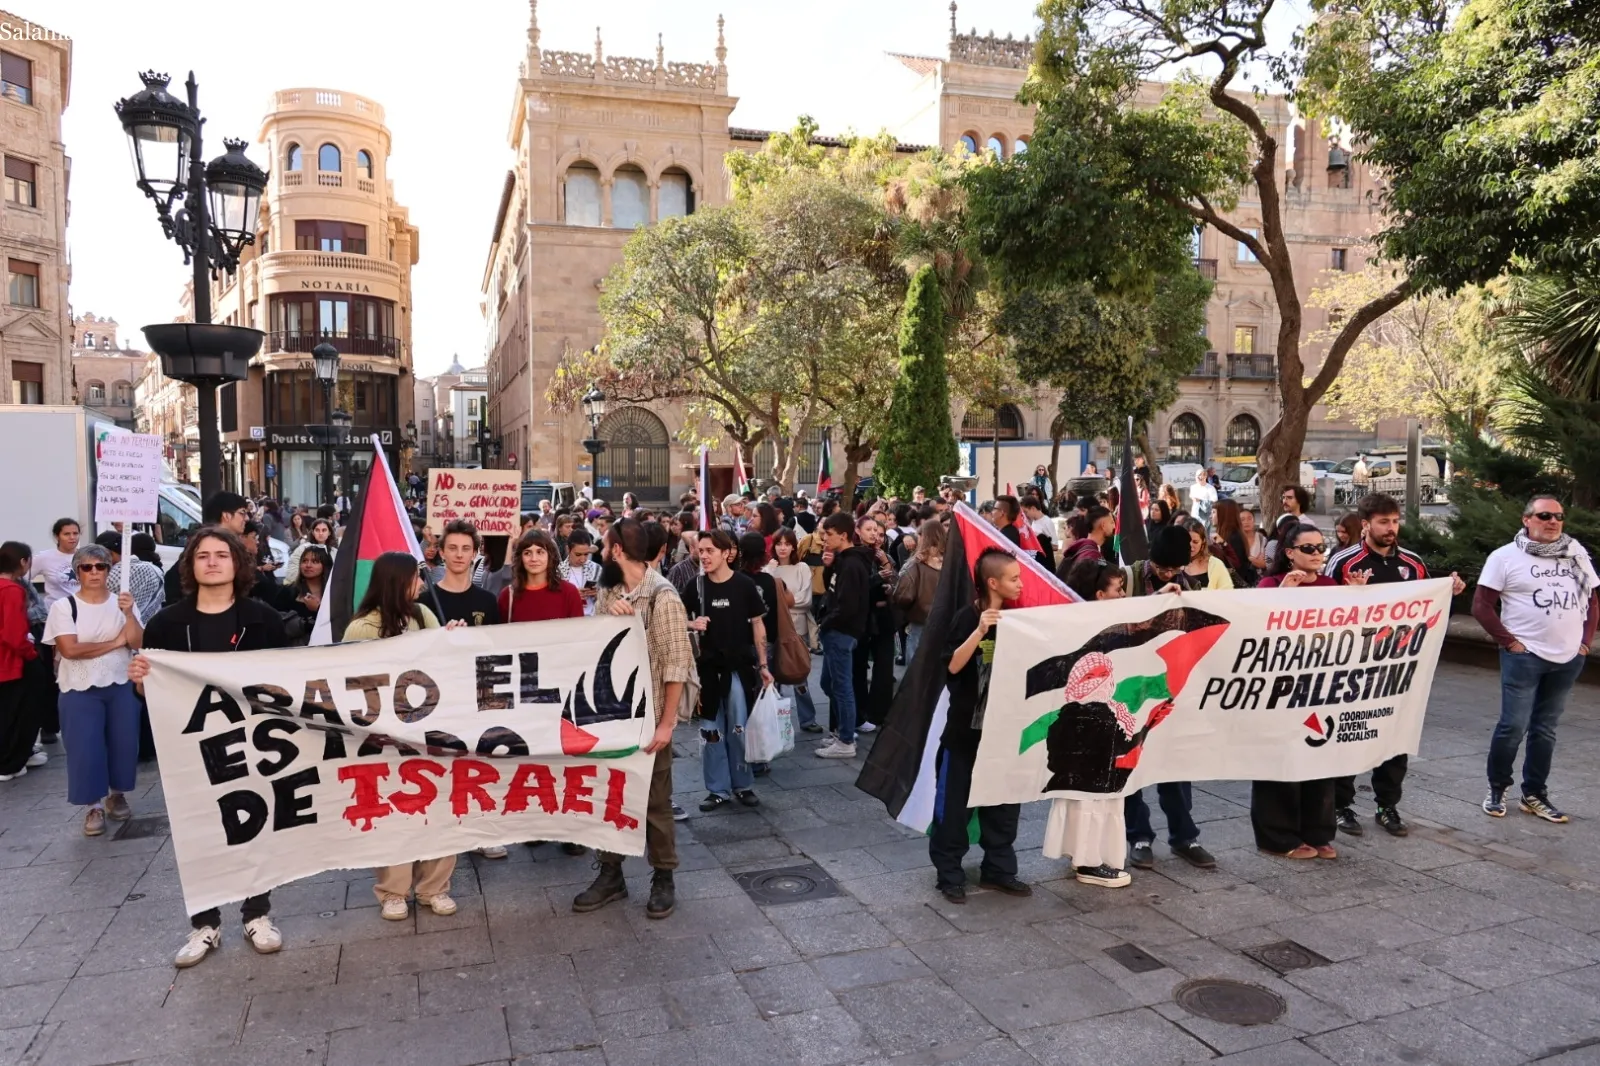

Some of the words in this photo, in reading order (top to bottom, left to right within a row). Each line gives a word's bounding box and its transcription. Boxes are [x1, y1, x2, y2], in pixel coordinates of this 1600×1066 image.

[301, 280, 370, 293] NOTARÍA
[272, 433, 315, 444] Deutsc
[435, 473, 455, 490] NO
[468, 483, 488, 491] una
[433, 495, 449, 508] ES
[469, 496, 519, 509] GENOCIDIO
[1533, 588, 1578, 610] GAZA
[1266, 605, 1359, 631] HUELGA
[1365, 604, 1387, 623] 15
[1390, 600, 1433, 621] OCT
[1231, 629, 1354, 674] PARARLO
[1359, 622, 1429, 663] TODO
[182, 670, 440, 734] ABAJO
[476, 652, 561, 712] EL
[1199, 677, 1267, 710] POR
[1266, 661, 1418, 710] PALESTINA
[1336, 729, 1378, 743] SOCIALISTA
[1337, 721, 1368, 733] JUVENIL
[217, 767, 320, 846] DE
[338, 759, 638, 832] ISRAEL
